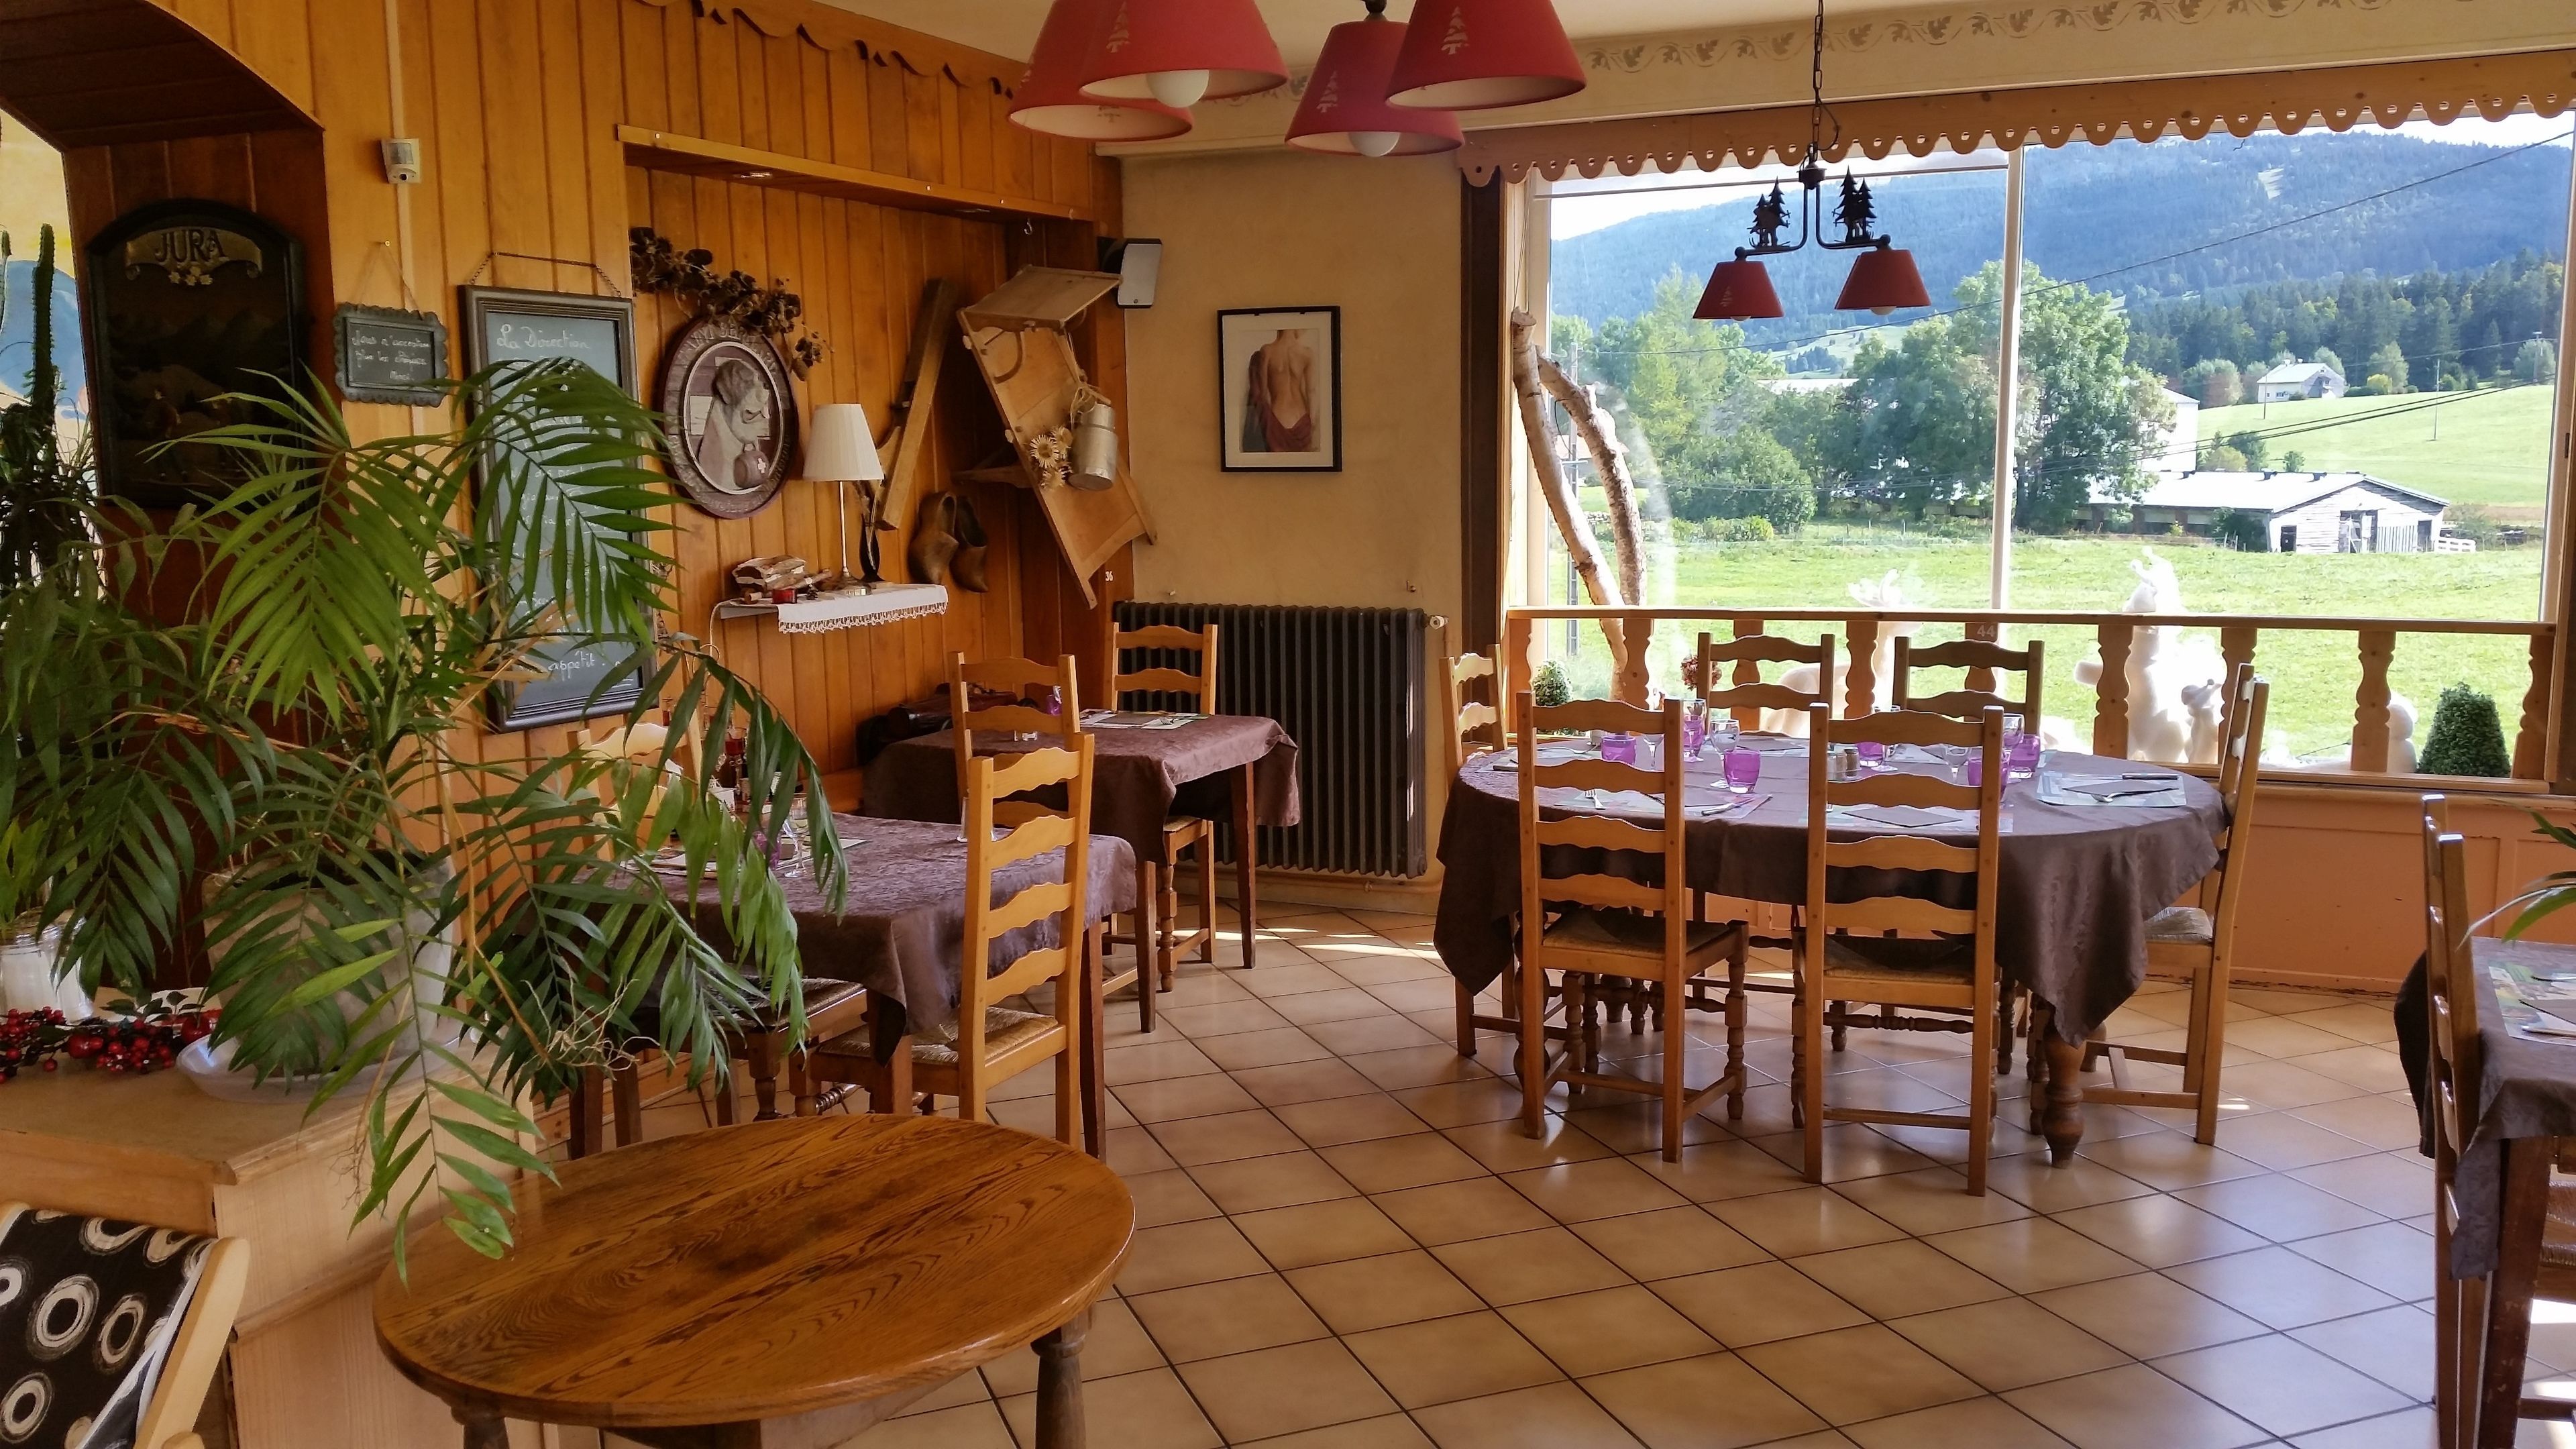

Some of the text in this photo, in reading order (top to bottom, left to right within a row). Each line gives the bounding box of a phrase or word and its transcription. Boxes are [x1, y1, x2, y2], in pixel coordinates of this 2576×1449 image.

[155, 229, 227, 262] JURA
[496, 323, 591, 350] La Direction
[1977, 625, 1996, 637] 44
[547, 650, 596, 682] appétit
